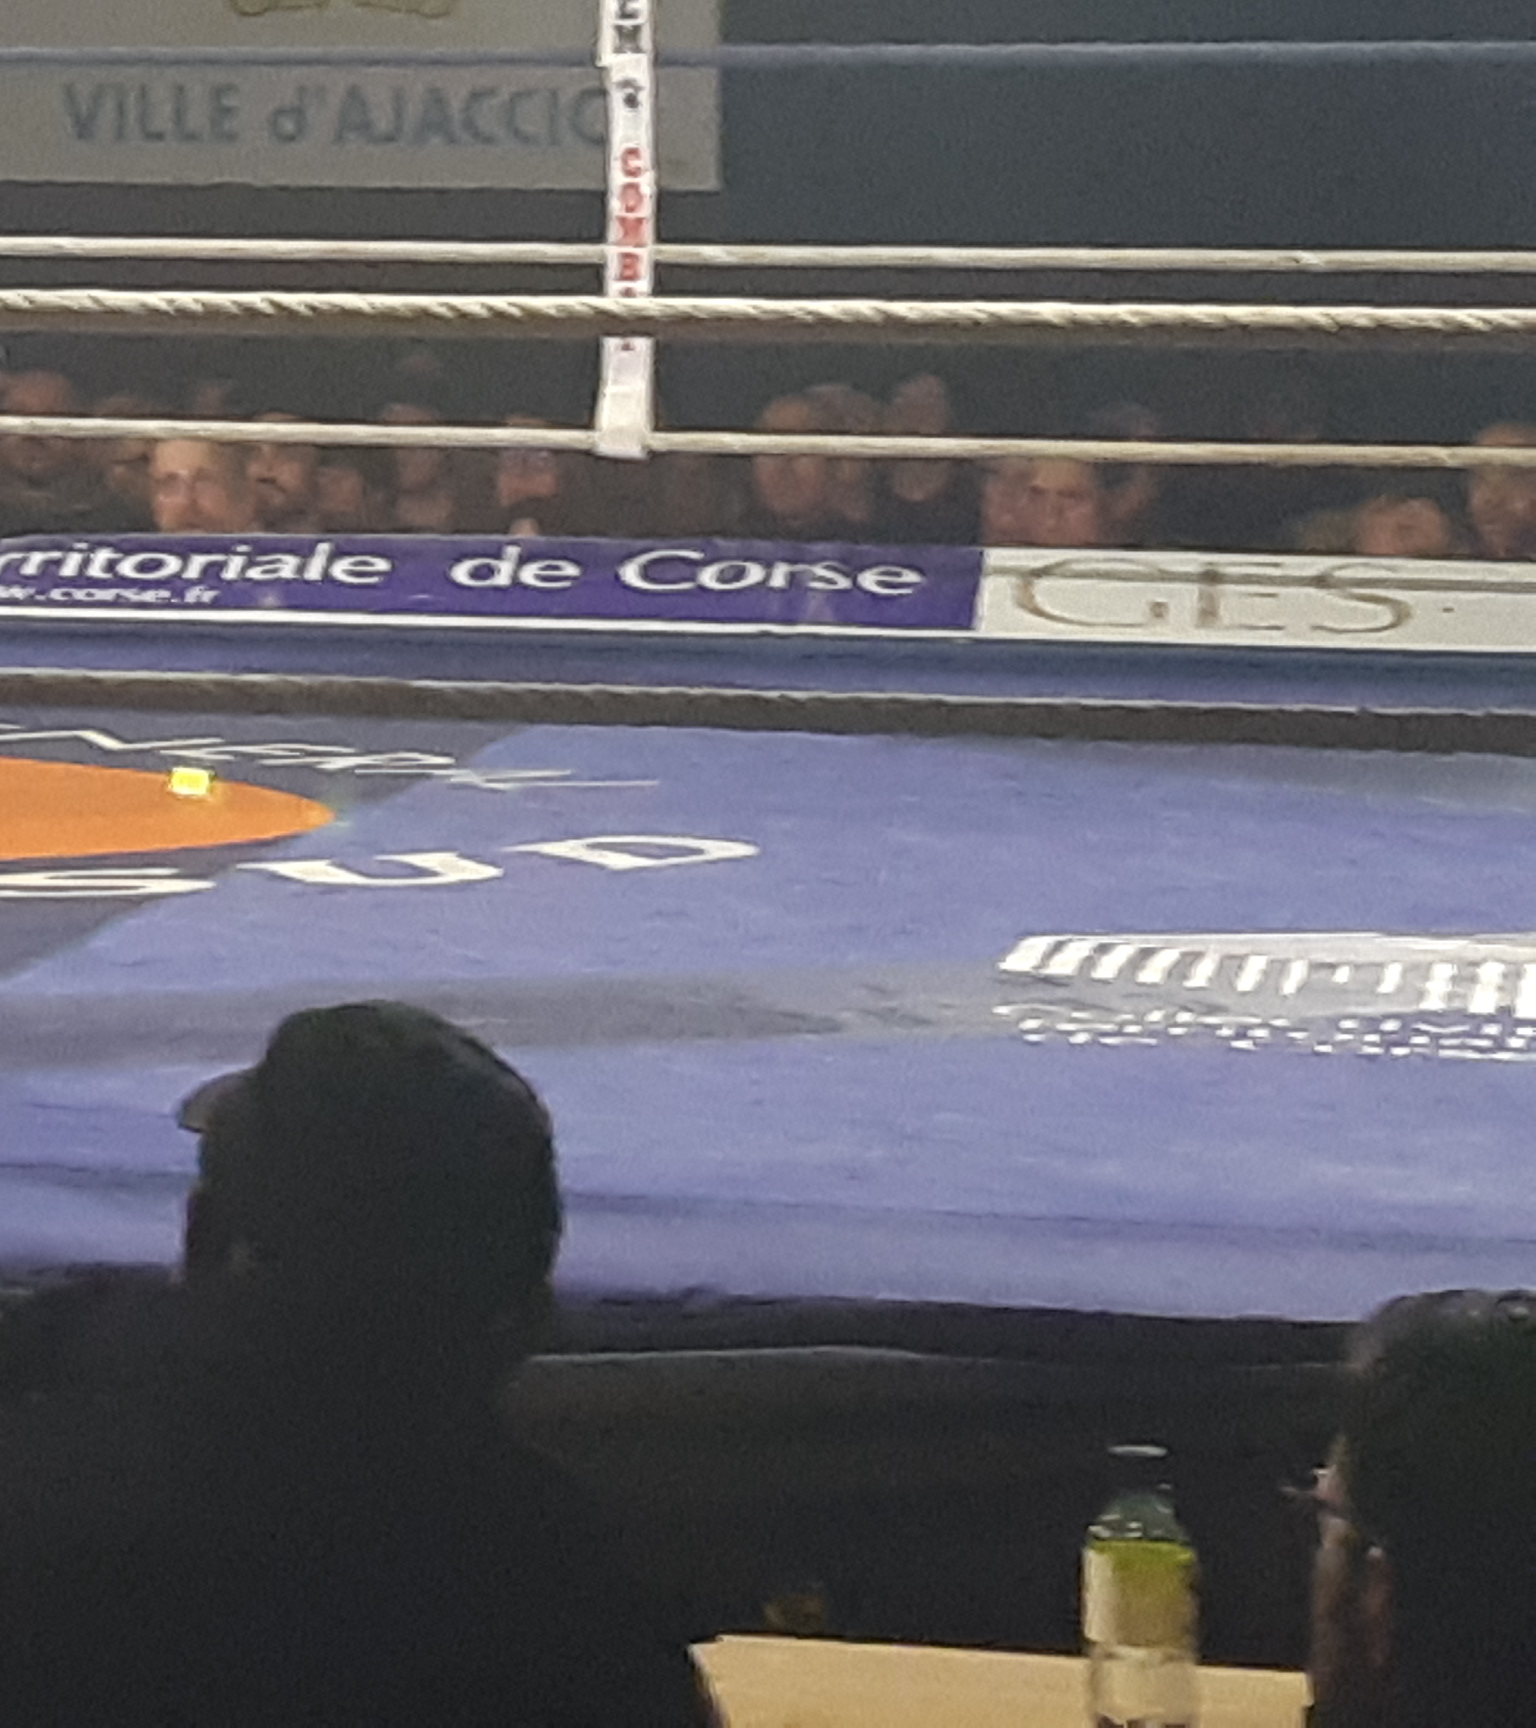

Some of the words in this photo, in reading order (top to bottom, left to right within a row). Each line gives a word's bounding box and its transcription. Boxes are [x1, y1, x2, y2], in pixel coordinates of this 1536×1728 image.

[61, 82, 242, 145] VILLE
[447, 543, 583, 590] de
[617, 550, 927, 595] Corse
